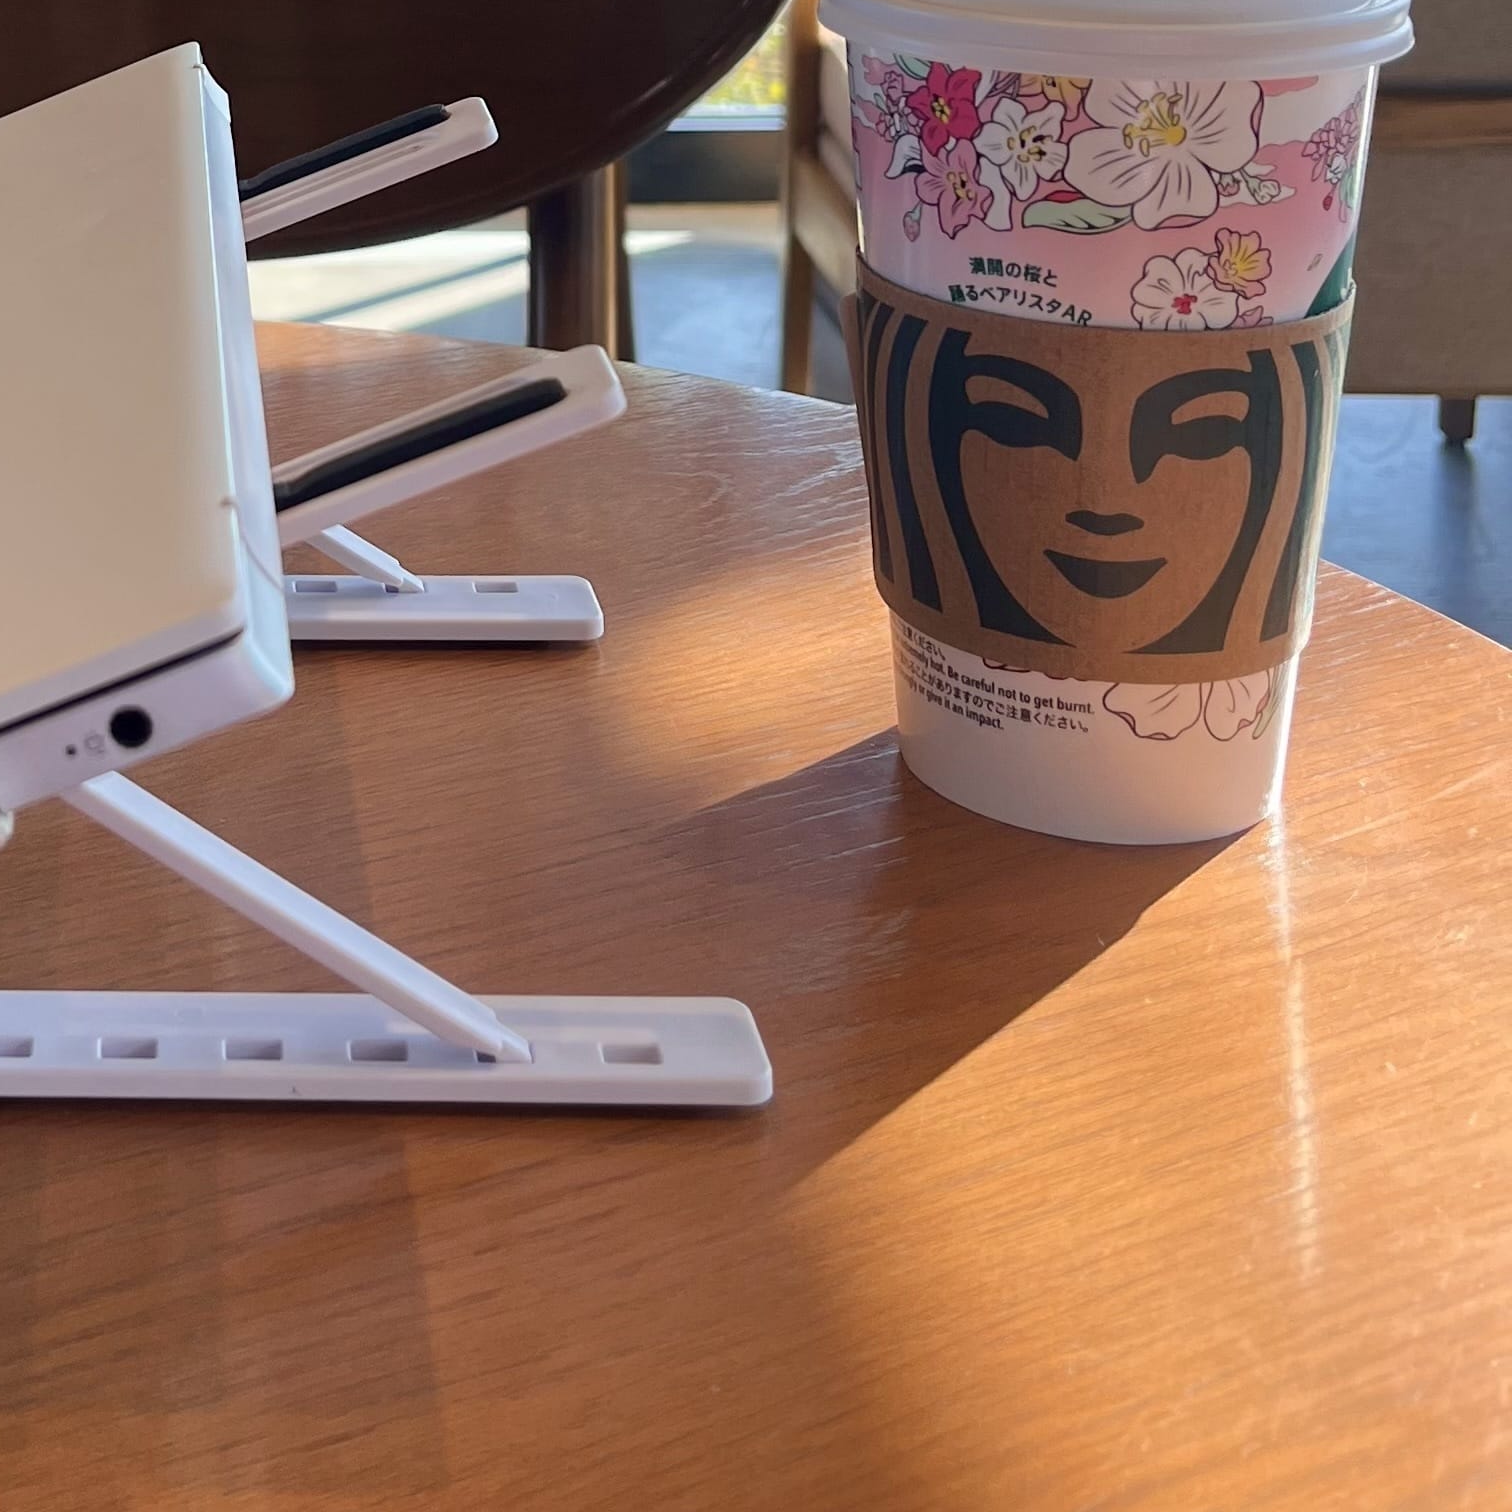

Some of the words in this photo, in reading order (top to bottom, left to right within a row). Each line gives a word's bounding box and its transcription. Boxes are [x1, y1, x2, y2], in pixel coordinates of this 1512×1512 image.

[968, 256, 1059, 288] 満開の桜と
[947, 665, 959, 681] Be
[961, 674, 995, 694] careful
[998, 686, 1017, 701] not
[1019, 691, 1031, 704] to
[1034, 696, 1054, 709] get
[1056, 696, 1095, 714] burnt.
[952, 703, 964, 716] an
[966, 706, 1005, 730] impact.
